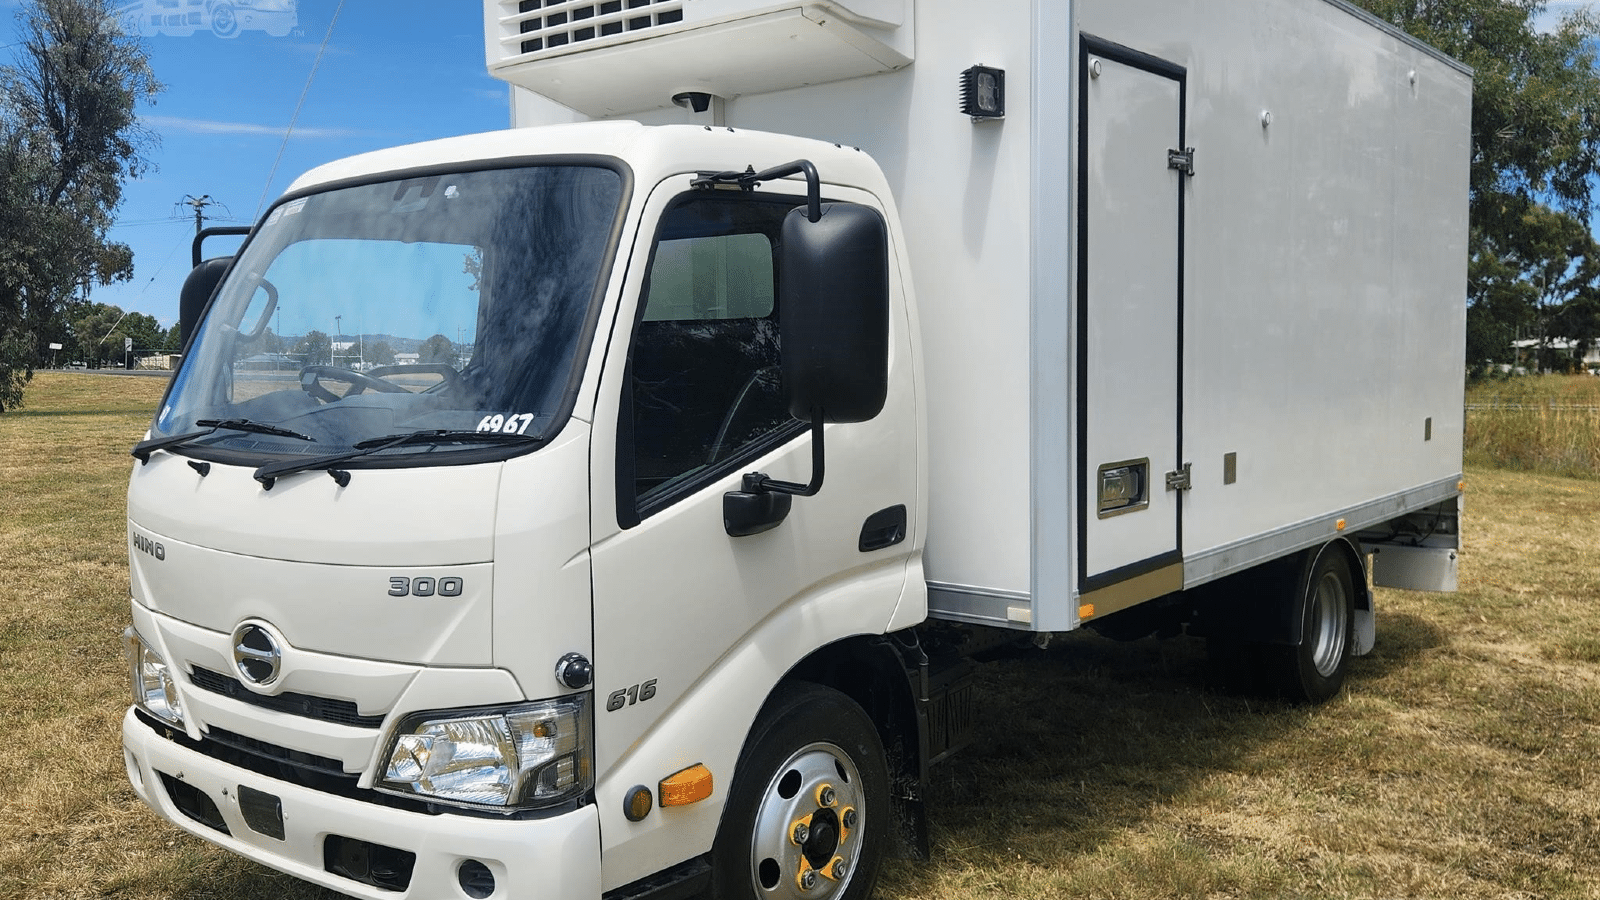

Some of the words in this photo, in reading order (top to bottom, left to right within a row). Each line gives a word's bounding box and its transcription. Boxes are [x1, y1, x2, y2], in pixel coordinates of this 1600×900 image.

[476, 412, 534, 435] 6967
[133, 531, 165, 561] HINO
[388, 576, 463, 597] 300
[606, 678, 658, 712] 616
